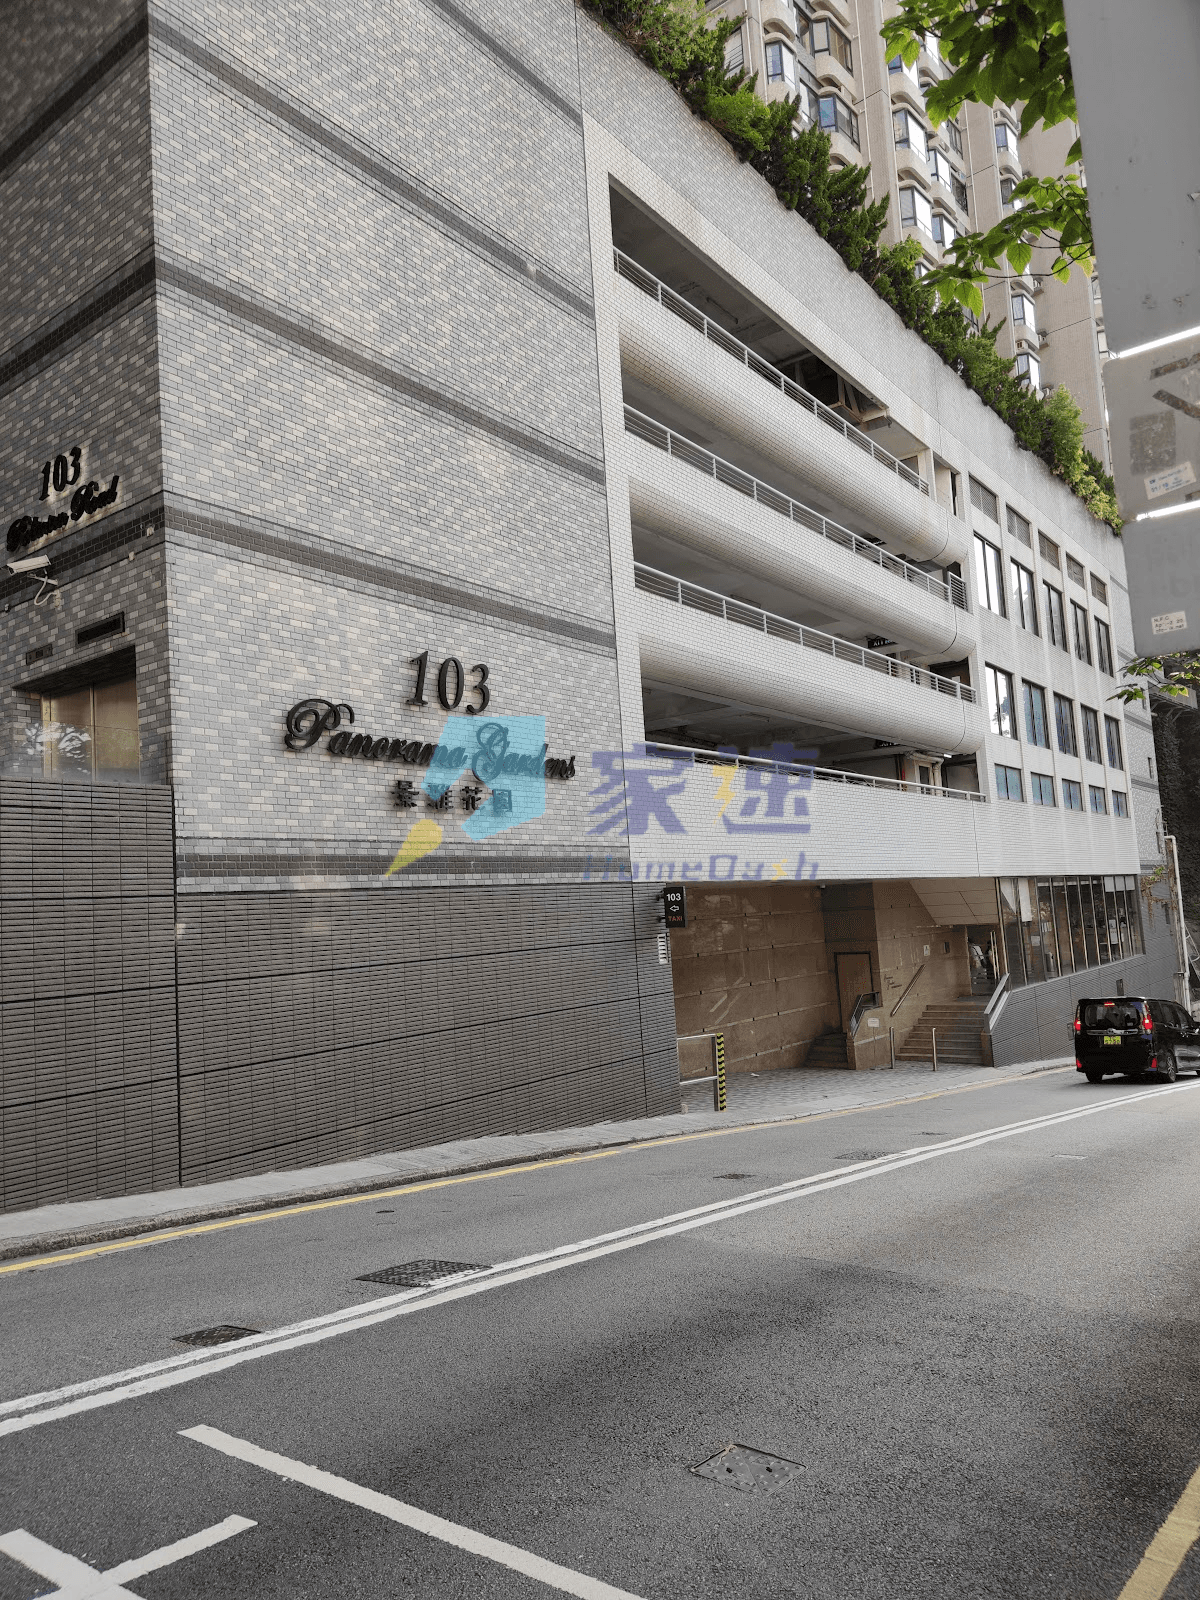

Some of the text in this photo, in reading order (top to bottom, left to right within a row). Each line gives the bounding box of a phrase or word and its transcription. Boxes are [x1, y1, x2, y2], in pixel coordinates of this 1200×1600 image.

[38, 446, 82, 501] 103
[406, 650, 490, 715] 103
[284, 698, 576, 782] Panorama Gardens
[666, 893, 682, 902] 103
